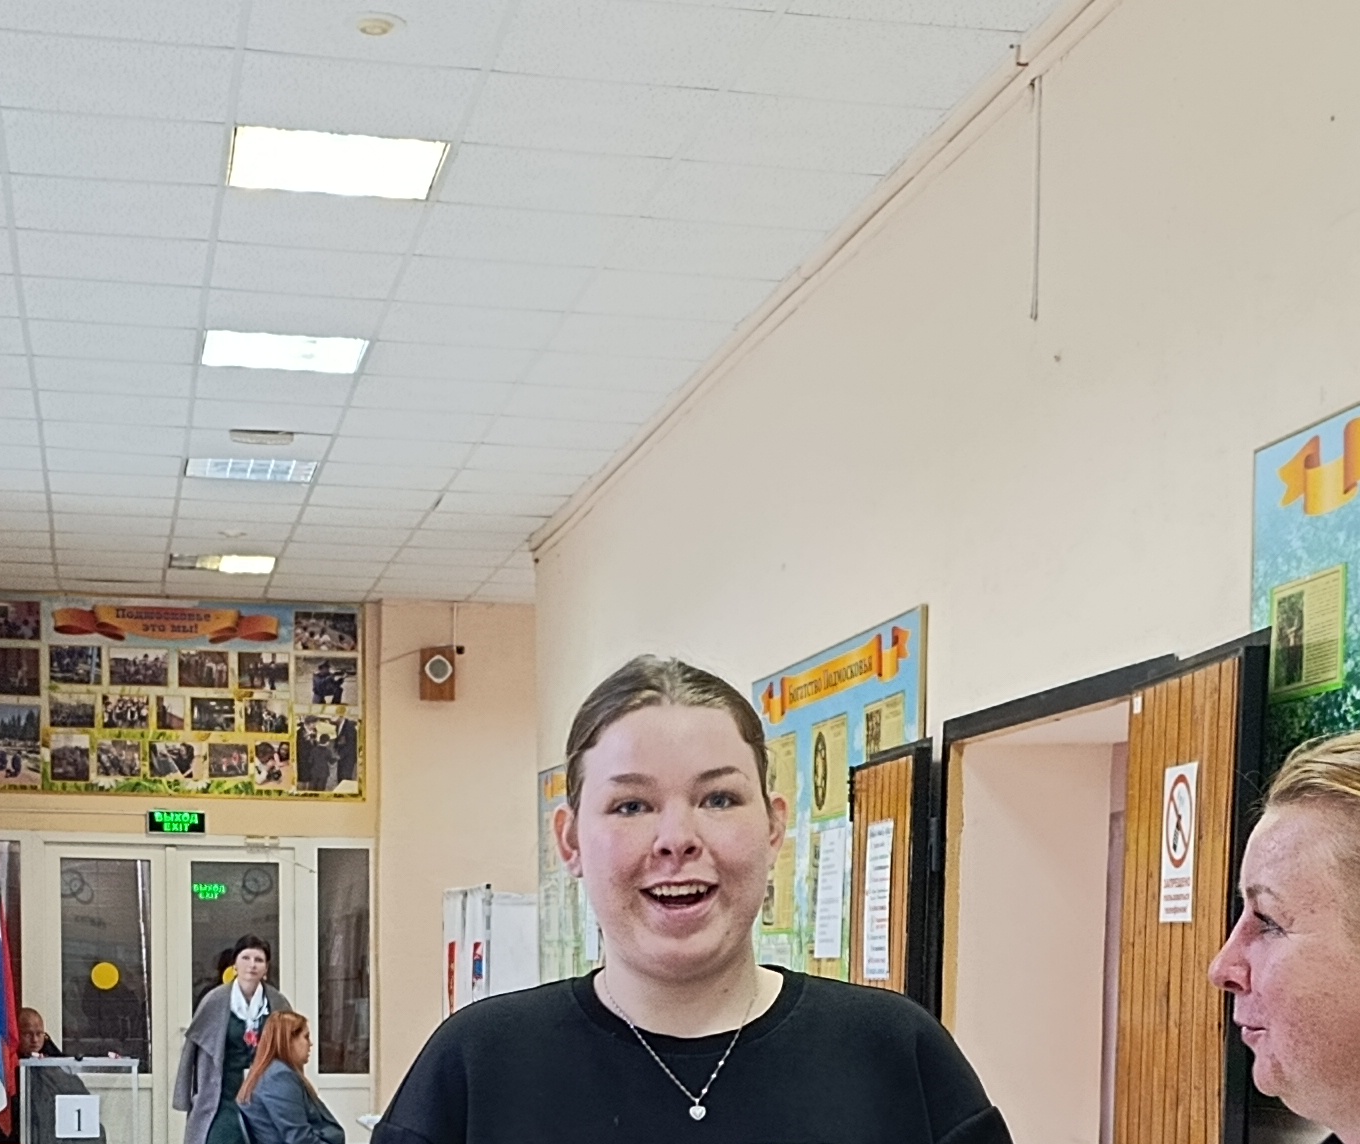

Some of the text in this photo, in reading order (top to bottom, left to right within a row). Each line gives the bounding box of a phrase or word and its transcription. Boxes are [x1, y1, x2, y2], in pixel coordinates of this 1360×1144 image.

[115, 608, 211, 622] Подмосковье
[142, 623, 166, 632] это
[154, 811, 198, 824] ВЫХОД
[163, 822, 190, 832] EXIT
[75, 1108, 82, 1132] 1
